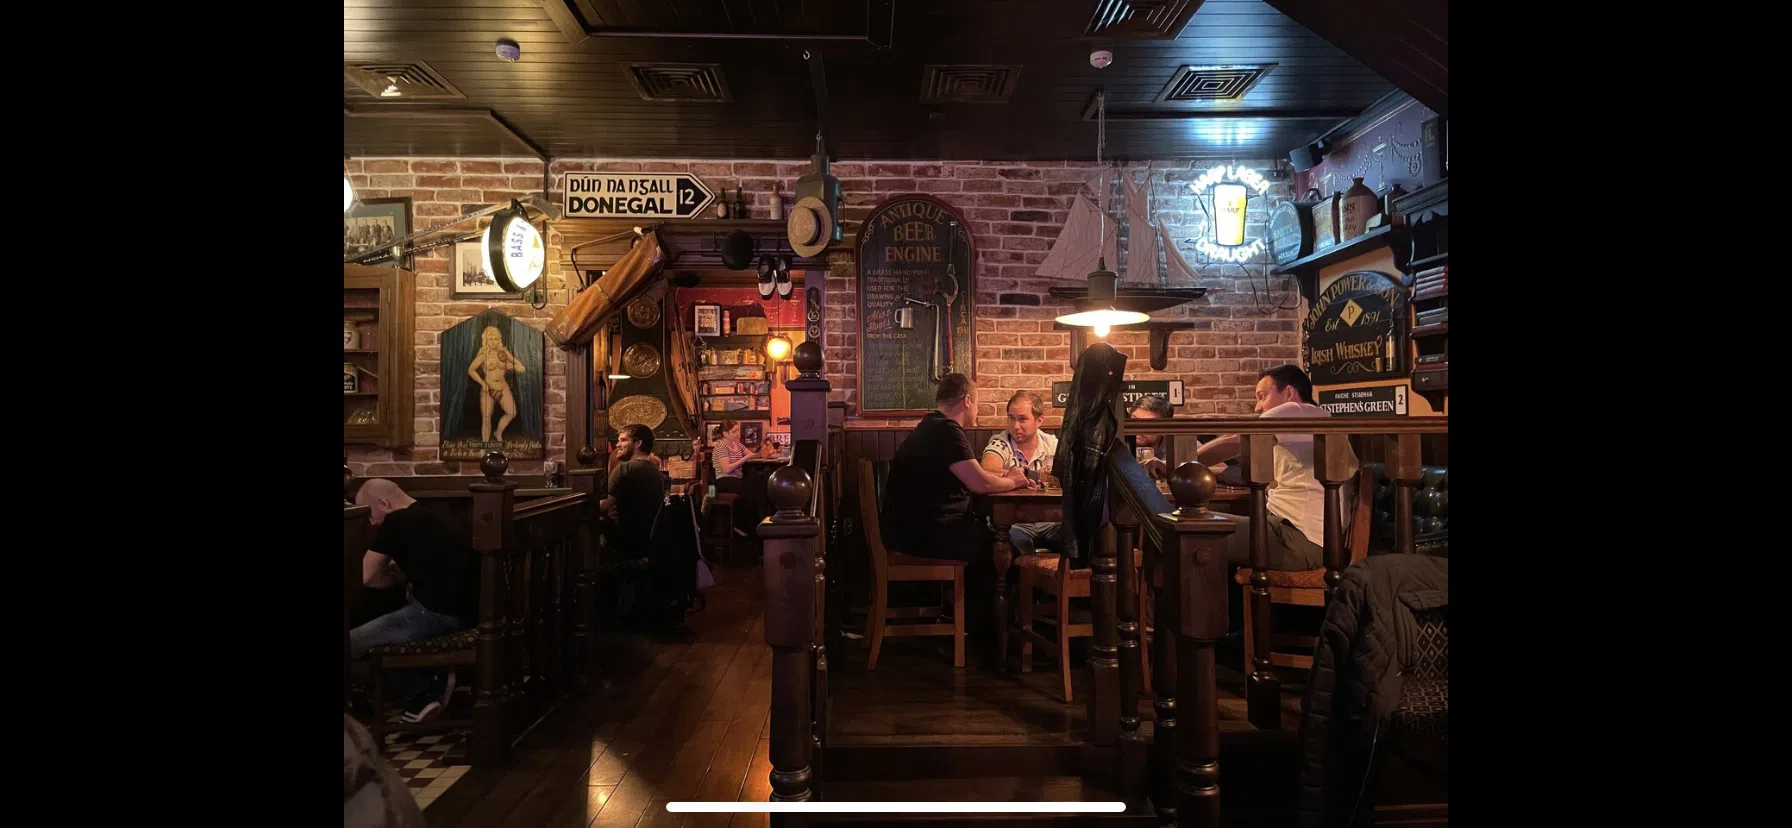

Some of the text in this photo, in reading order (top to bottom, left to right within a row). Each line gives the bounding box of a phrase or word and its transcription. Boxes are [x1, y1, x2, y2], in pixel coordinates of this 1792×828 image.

[568, 196, 674, 214] DONEGAL
[680, 188, 695, 205] 12
[880, 202, 948, 229] ANTIQUE
[893, 221, 936, 241] BEER
[511, 232, 524, 258] BASS
[885, 246, 942, 262] ENGINE
[1308, 292, 1331, 330] JOHN
[1330, 274, 1367, 300] POWER
[1348, 306, 1355, 319] P
[1325, 318, 1340, 332] Est
[1311, 335, 1383, 366] IRISH WHISKEY
[1364, 400, 1394, 412] GREEN
[1397, 394, 1404, 405] 2
